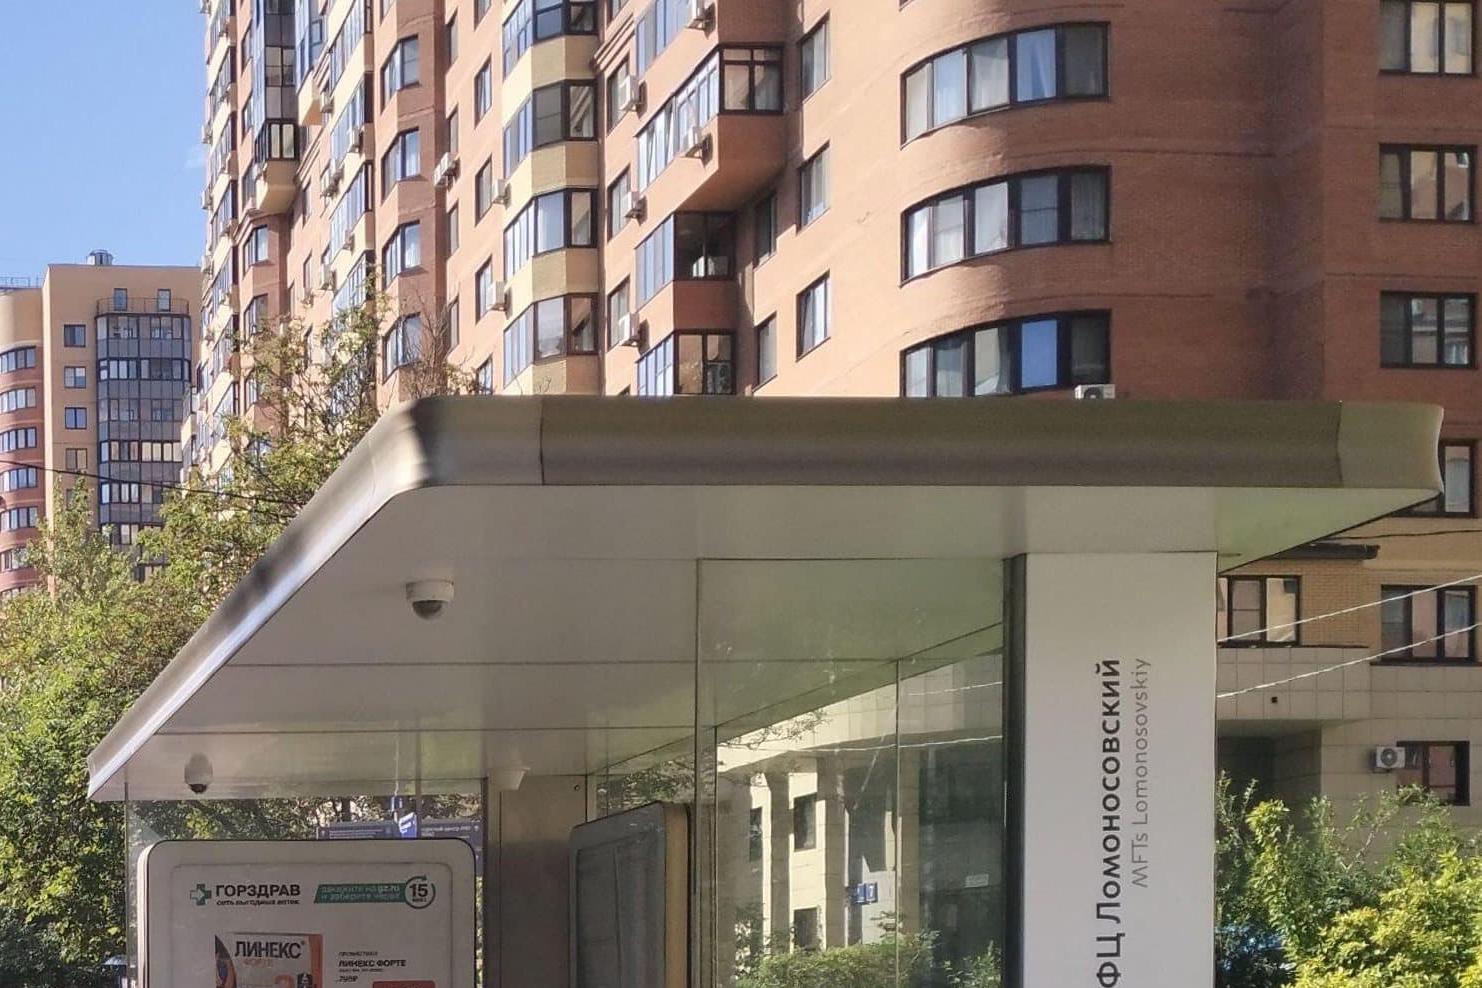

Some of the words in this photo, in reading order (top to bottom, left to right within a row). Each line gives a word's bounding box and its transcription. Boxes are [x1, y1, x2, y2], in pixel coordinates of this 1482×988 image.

[1130, 657, 1152, 825] Lomonosovskiy
[1095, 658, 1122, 924] Ломоносовский
[1130, 831, 1149, 889] MFTs
[215, 884, 301, 898] ГОРЗДРАВ
[409, 883, 428, 898] 15
[234, 940, 302, 959] ЛИНЕКС
[338, 959, 375, 967] ЛИНЕКС
[376, 959, 407, 967] ФОРТЕ
